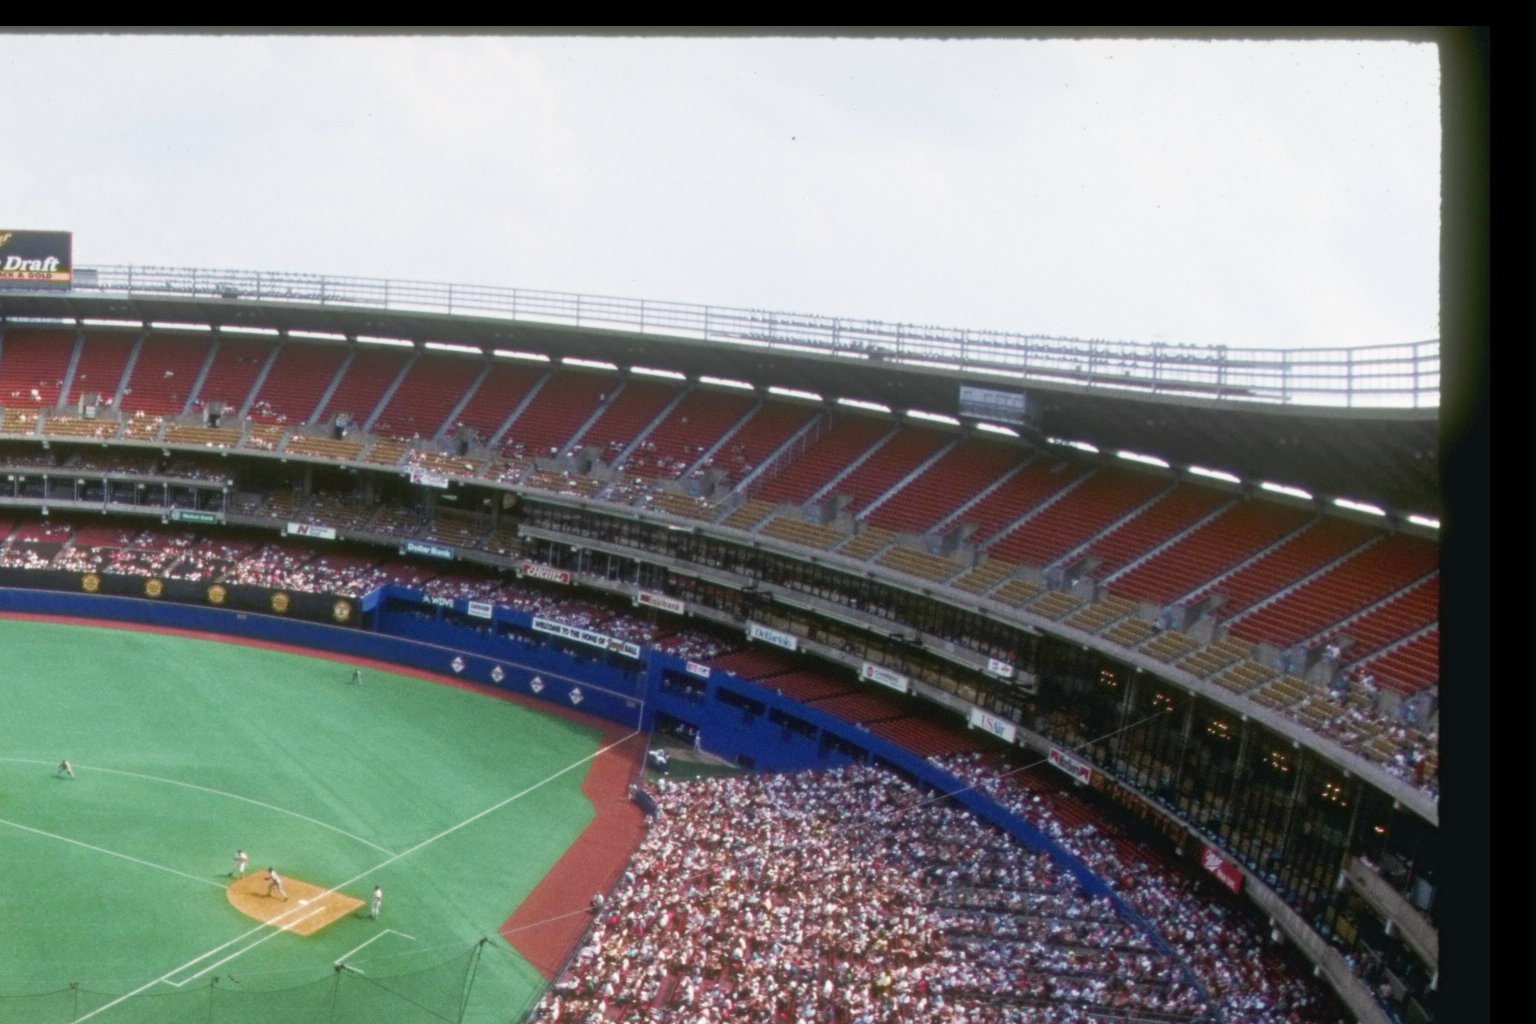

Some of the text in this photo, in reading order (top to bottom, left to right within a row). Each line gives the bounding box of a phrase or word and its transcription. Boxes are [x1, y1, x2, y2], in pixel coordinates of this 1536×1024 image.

[4, 256, 59, 272] Draft
[430, 547, 451, 557] Bank
[535, 621, 561, 632] WELCOME
[570, 629, 580, 638] THE
[581, 631, 597, 642] HOME
[598, 636, 606, 644] OF
[981, 714, 1005, 735] USAir
